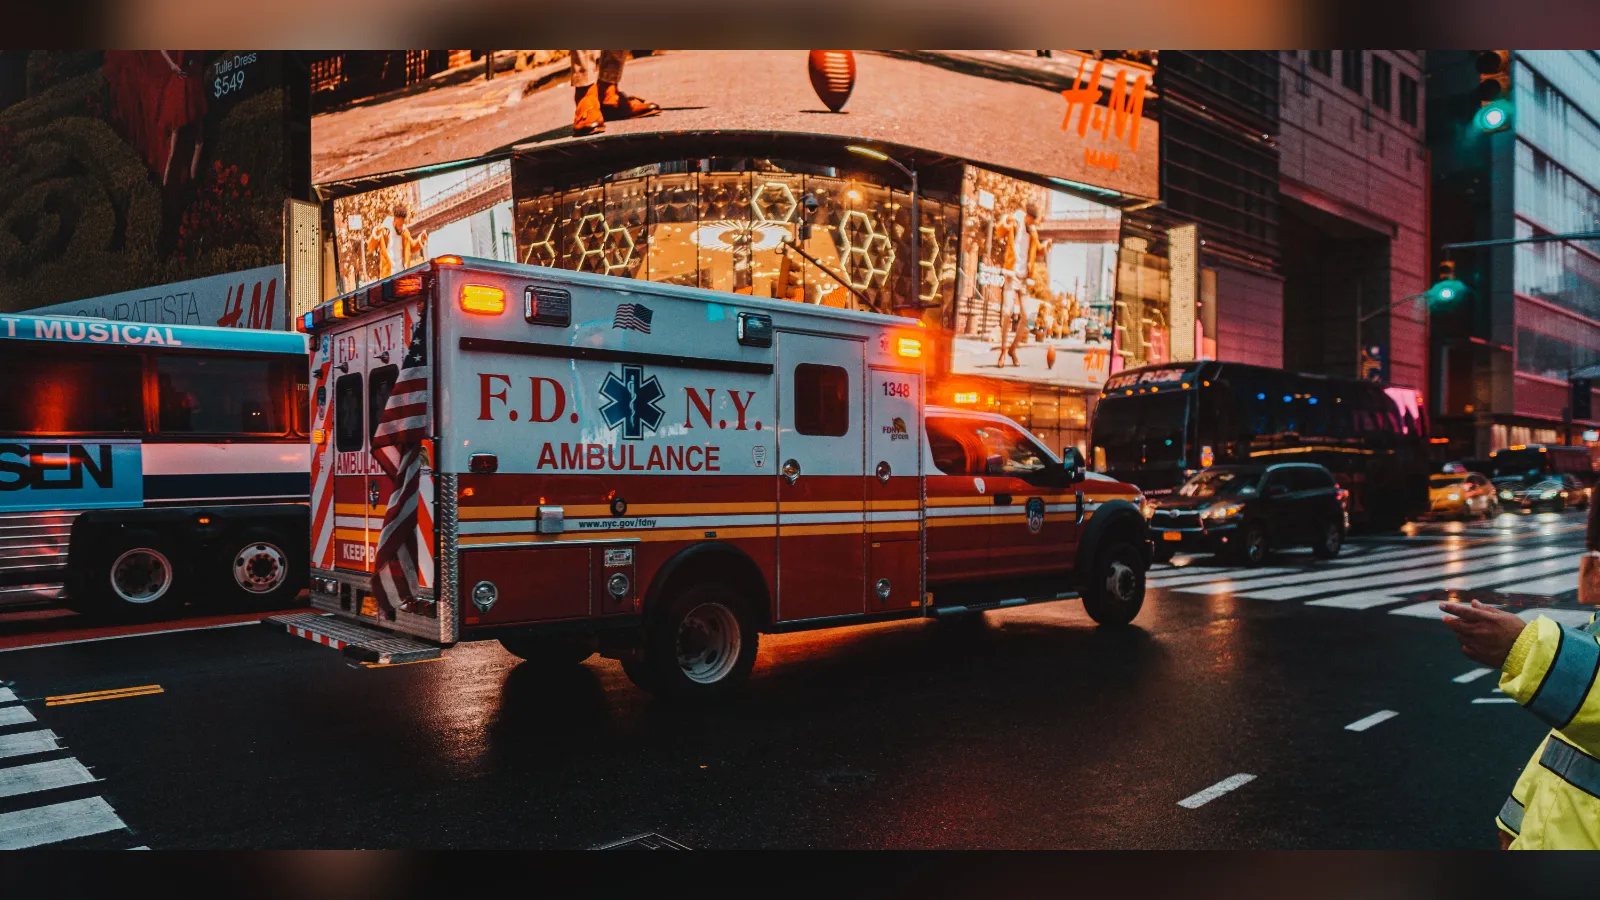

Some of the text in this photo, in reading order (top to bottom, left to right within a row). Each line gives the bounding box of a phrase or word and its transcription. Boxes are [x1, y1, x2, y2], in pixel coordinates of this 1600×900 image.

[214, 53, 257, 75] Tulle Dress
[214, 70, 245, 99] $549
[1060, 56, 1146, 152] H&M
[76, 291, 201, 324] BATTISTA
[35, 320, 182, 346] MUSICAL
[1083, 347, 1107, 372] HM
[476, 372, 763, 431] F.D. N.Y.
[882, 381, 910, 398] 1348
[890, 433, 909, 442] green
[536, 442, 721, 472] AMBULANCE
[578, 518, 657, 528] www.nyc.gov/fdny
[343, 543, 366, 561] KEEP
